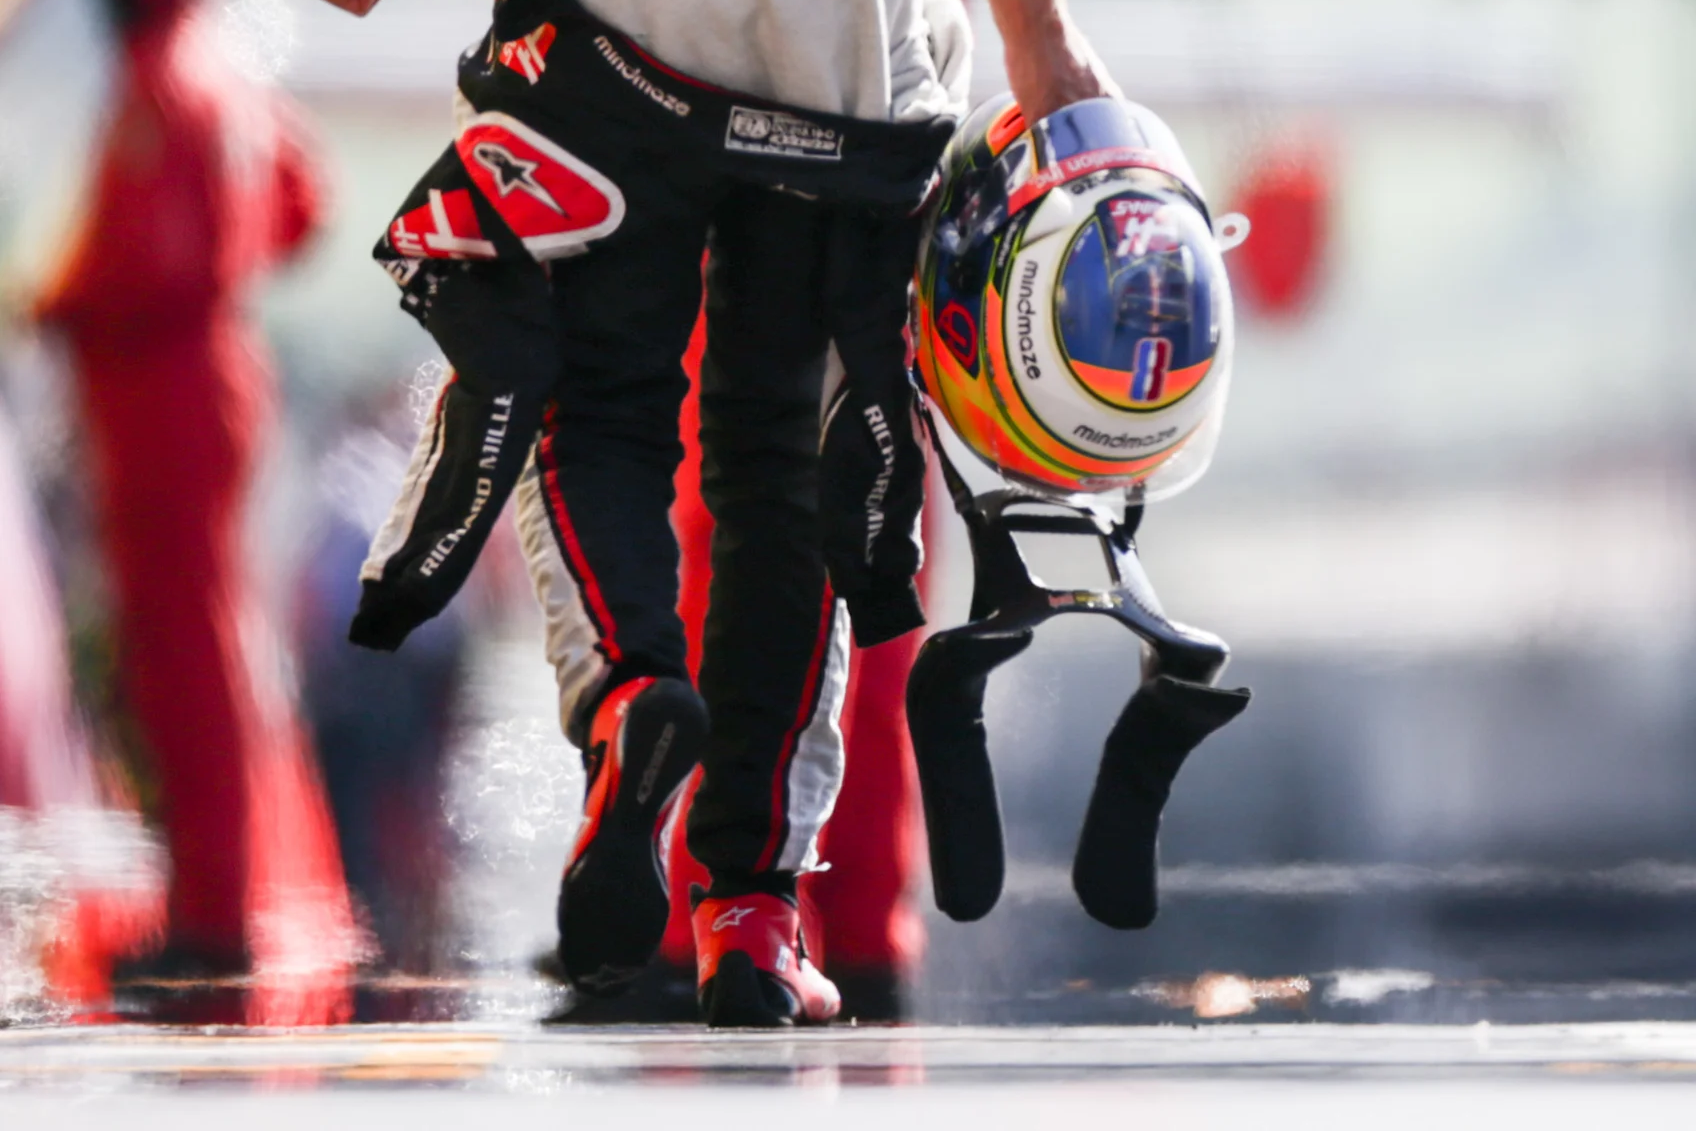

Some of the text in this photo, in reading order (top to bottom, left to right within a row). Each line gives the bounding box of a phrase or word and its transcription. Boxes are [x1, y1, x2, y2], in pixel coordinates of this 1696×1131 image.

[593, 34, 692, 117] mindmaze
[1017, 260, 1041, 381] mindmaze
[419, 392, 514, 577] RICHARD MILLE
[1073, 423, 1178, 449] mindmaze
